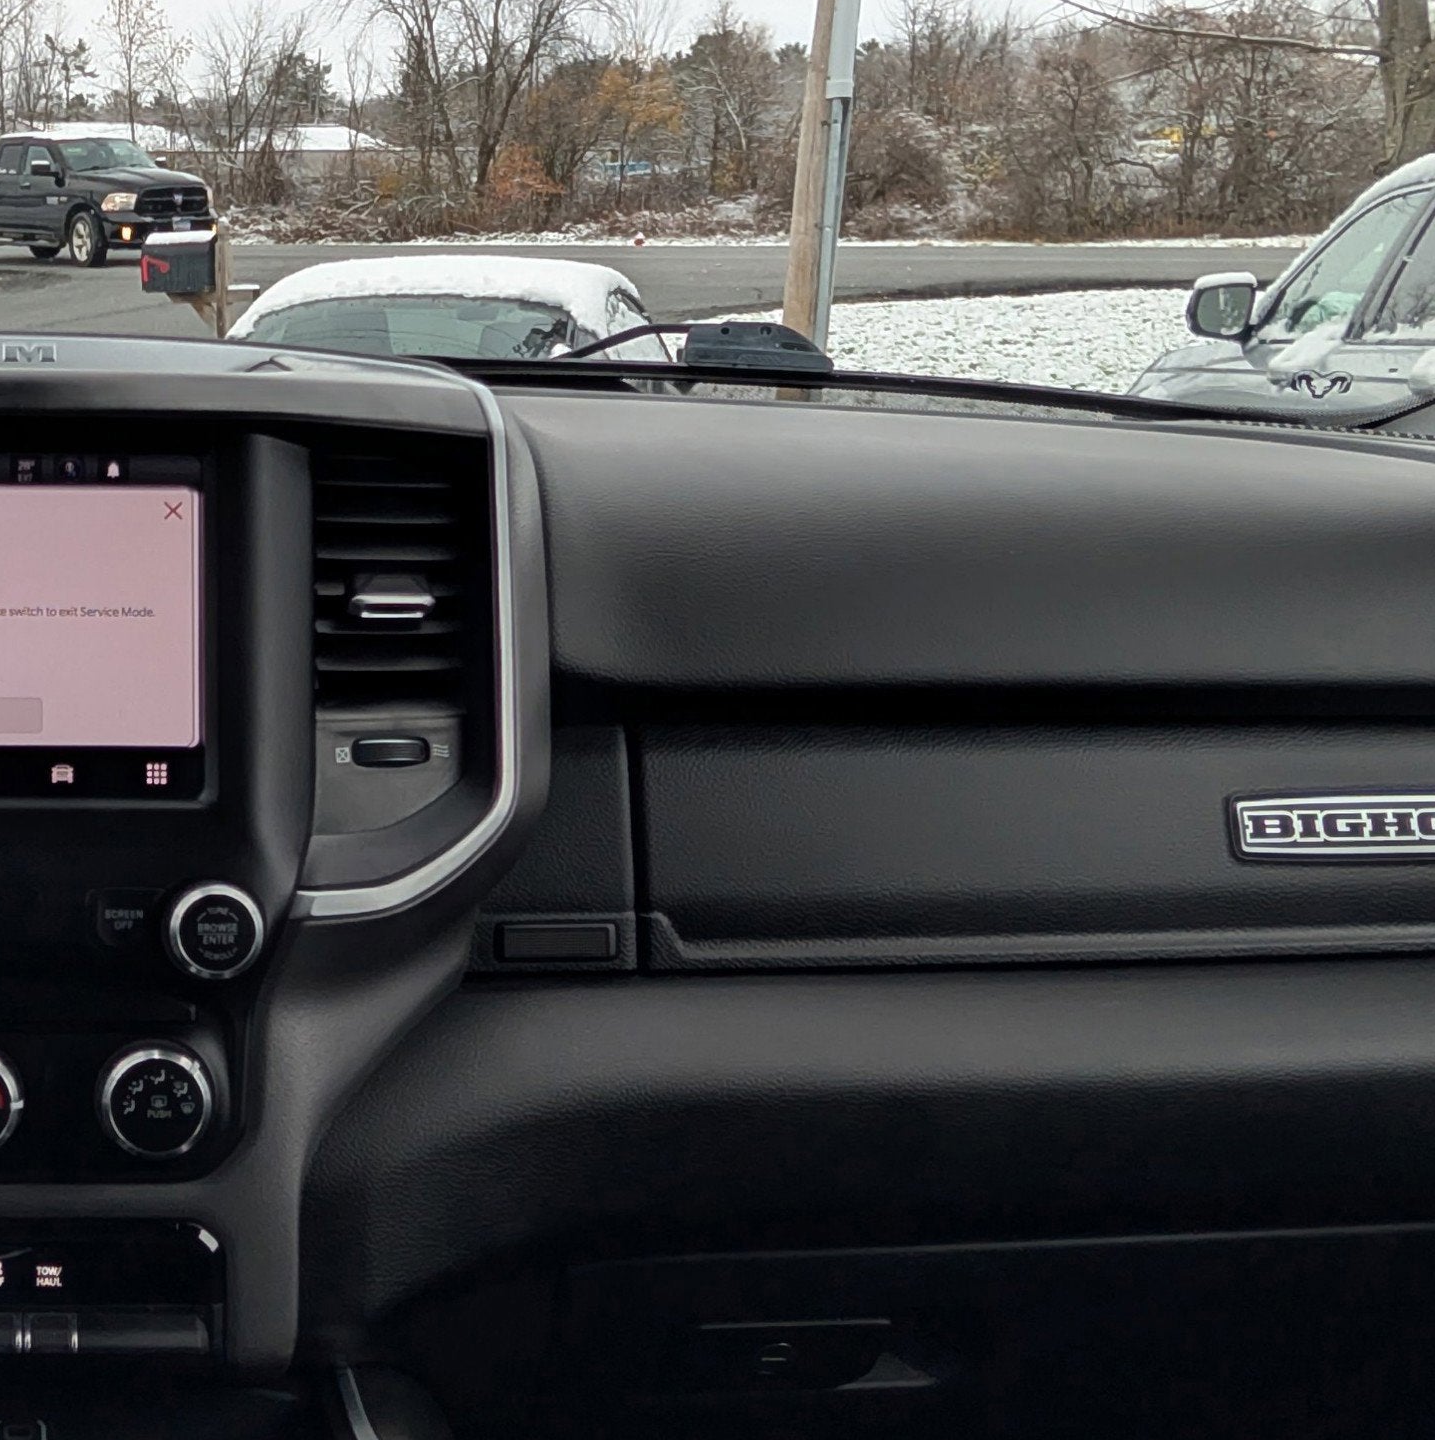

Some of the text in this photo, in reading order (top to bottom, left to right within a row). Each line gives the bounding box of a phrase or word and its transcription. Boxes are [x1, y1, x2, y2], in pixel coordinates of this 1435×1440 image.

[9, 607, 43, 617] switch
[46, 607, 58, 617] to
[59, 607, 78, 617] exit
[80, 607, 120, 617] Service
[203, 935, 235, 945] ENTER
[36, 1265, 62, 1276] TOW/
[36, 1277, 63, 1287] HAUL
